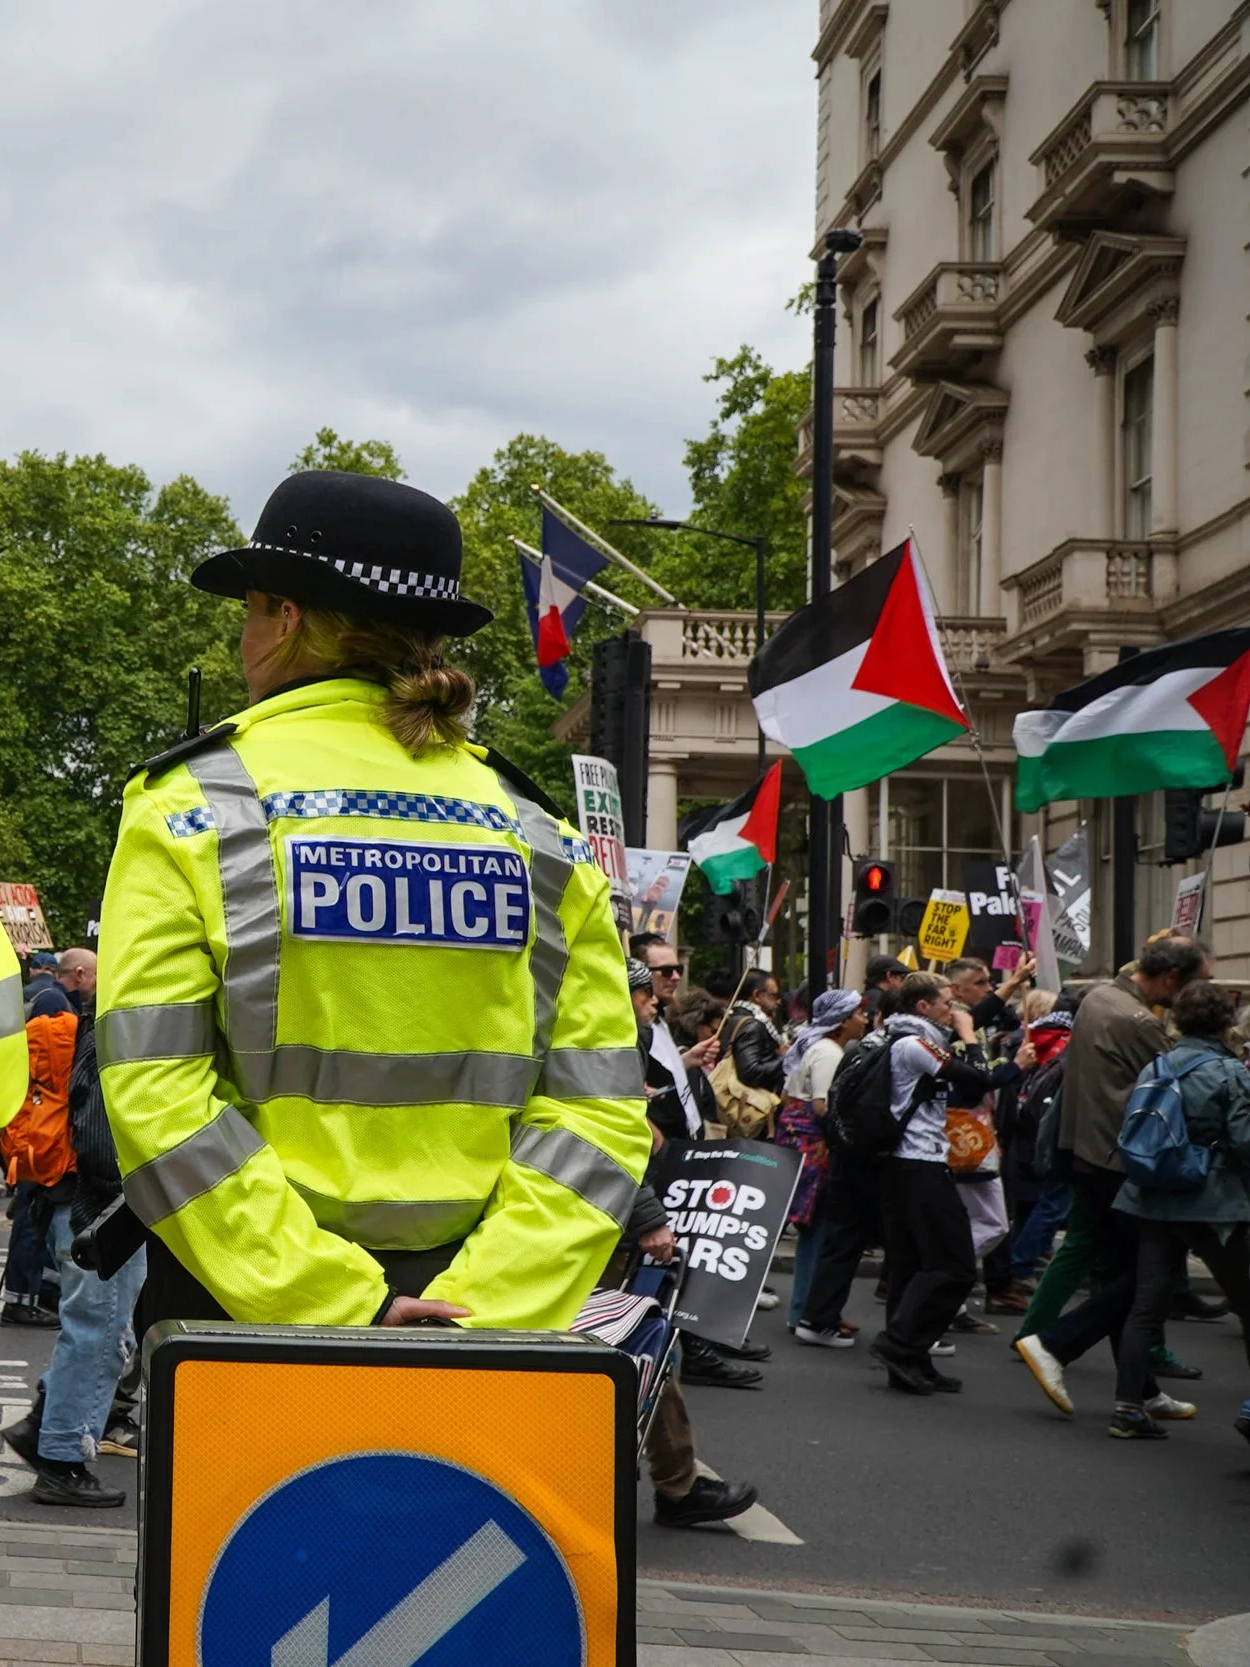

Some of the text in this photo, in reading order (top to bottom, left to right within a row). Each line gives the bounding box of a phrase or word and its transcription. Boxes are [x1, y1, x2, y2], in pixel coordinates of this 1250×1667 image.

[300, 845, 522, 877] METROPOLITAN
[301, 872, 523, 939] POLICE
[934, 902, 962, 915] STOP
[926, 924, 946, 936] FAR
[931, 913, 950, 926] THE
[923, 935, 957, 949] RIGHT
[663, 1179, 766, 1216] STOP
[665, 1211, 768, 1251] RUMP'S
